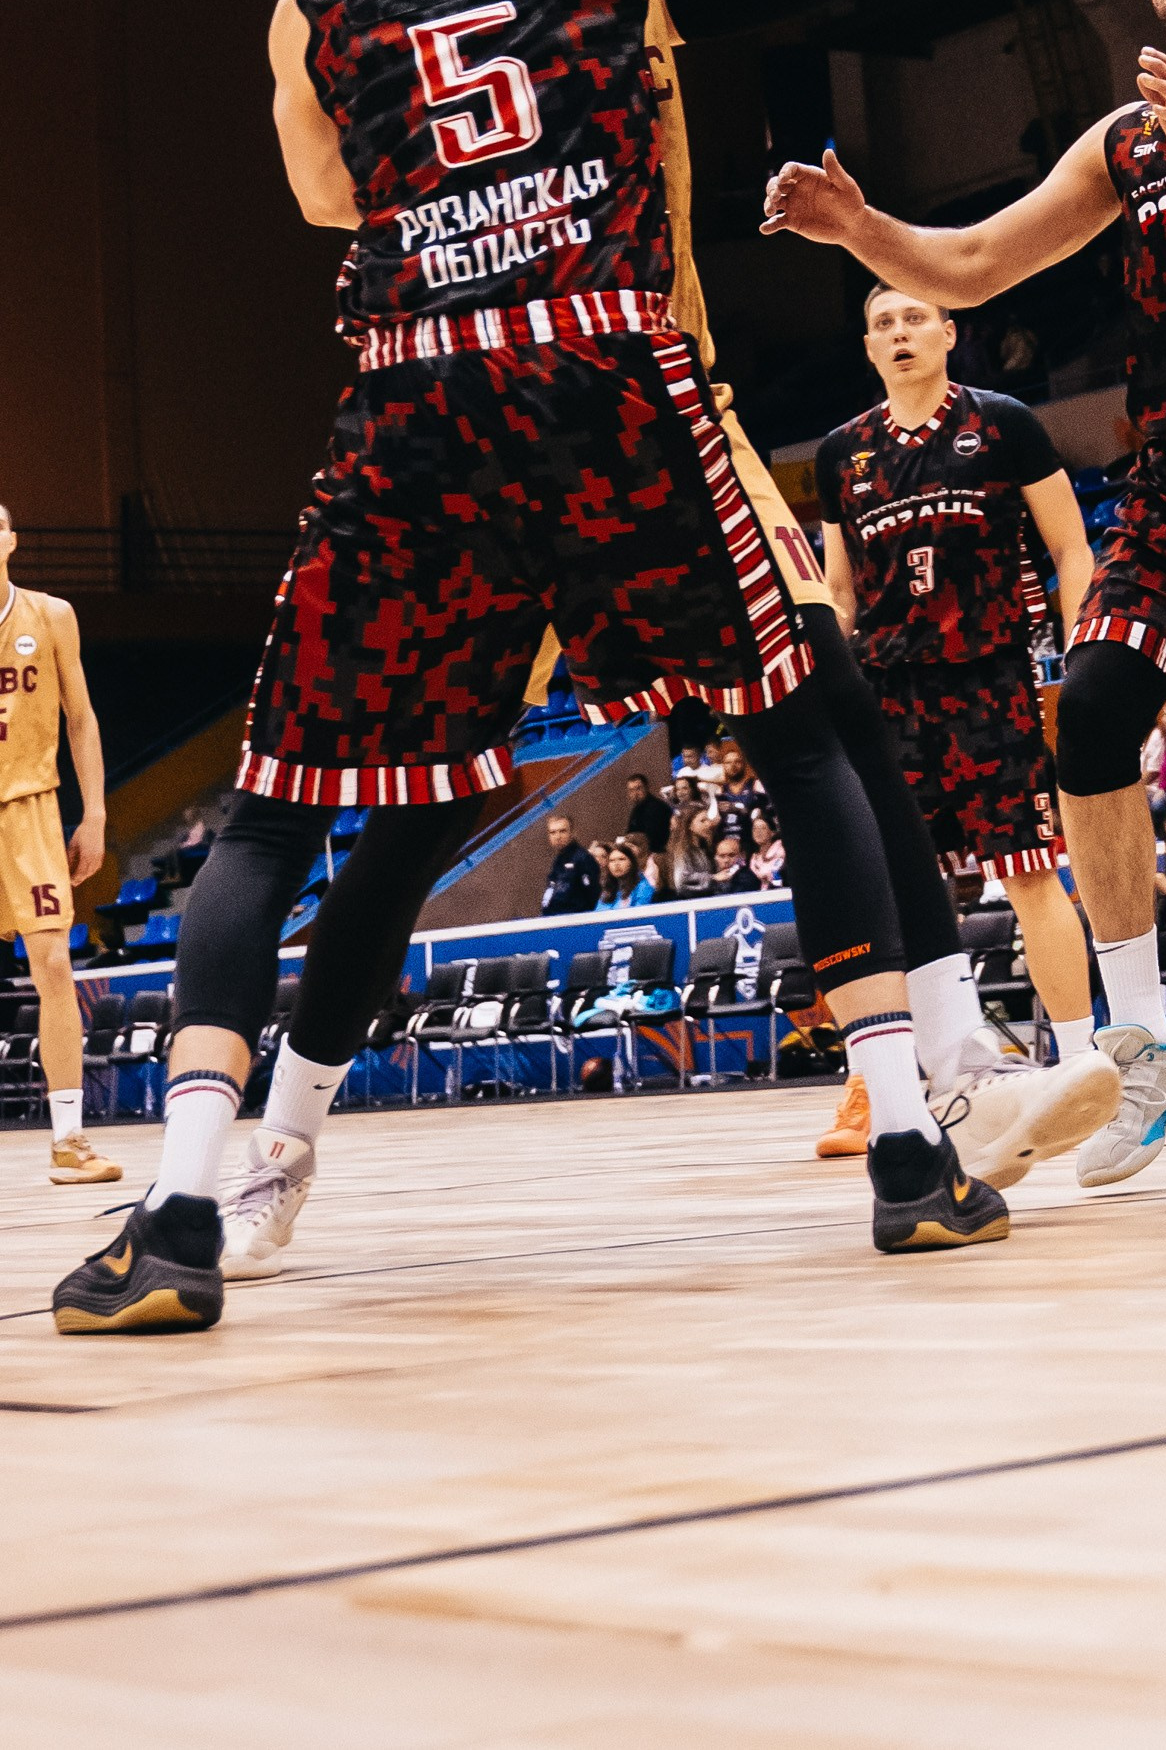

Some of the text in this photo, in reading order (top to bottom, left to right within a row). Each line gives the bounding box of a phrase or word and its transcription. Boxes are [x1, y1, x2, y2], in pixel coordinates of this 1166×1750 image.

[407, 0, 543, 169] 5
[394, 156, 610, 251] РЯЗАНСКАЯ
[419, 212, 593, 290] ОБЛАСТЬ
[906, 545, 936, 597] 3
[0, 665, 38, 695] ВС
[30, 883, 61, 918] 15
